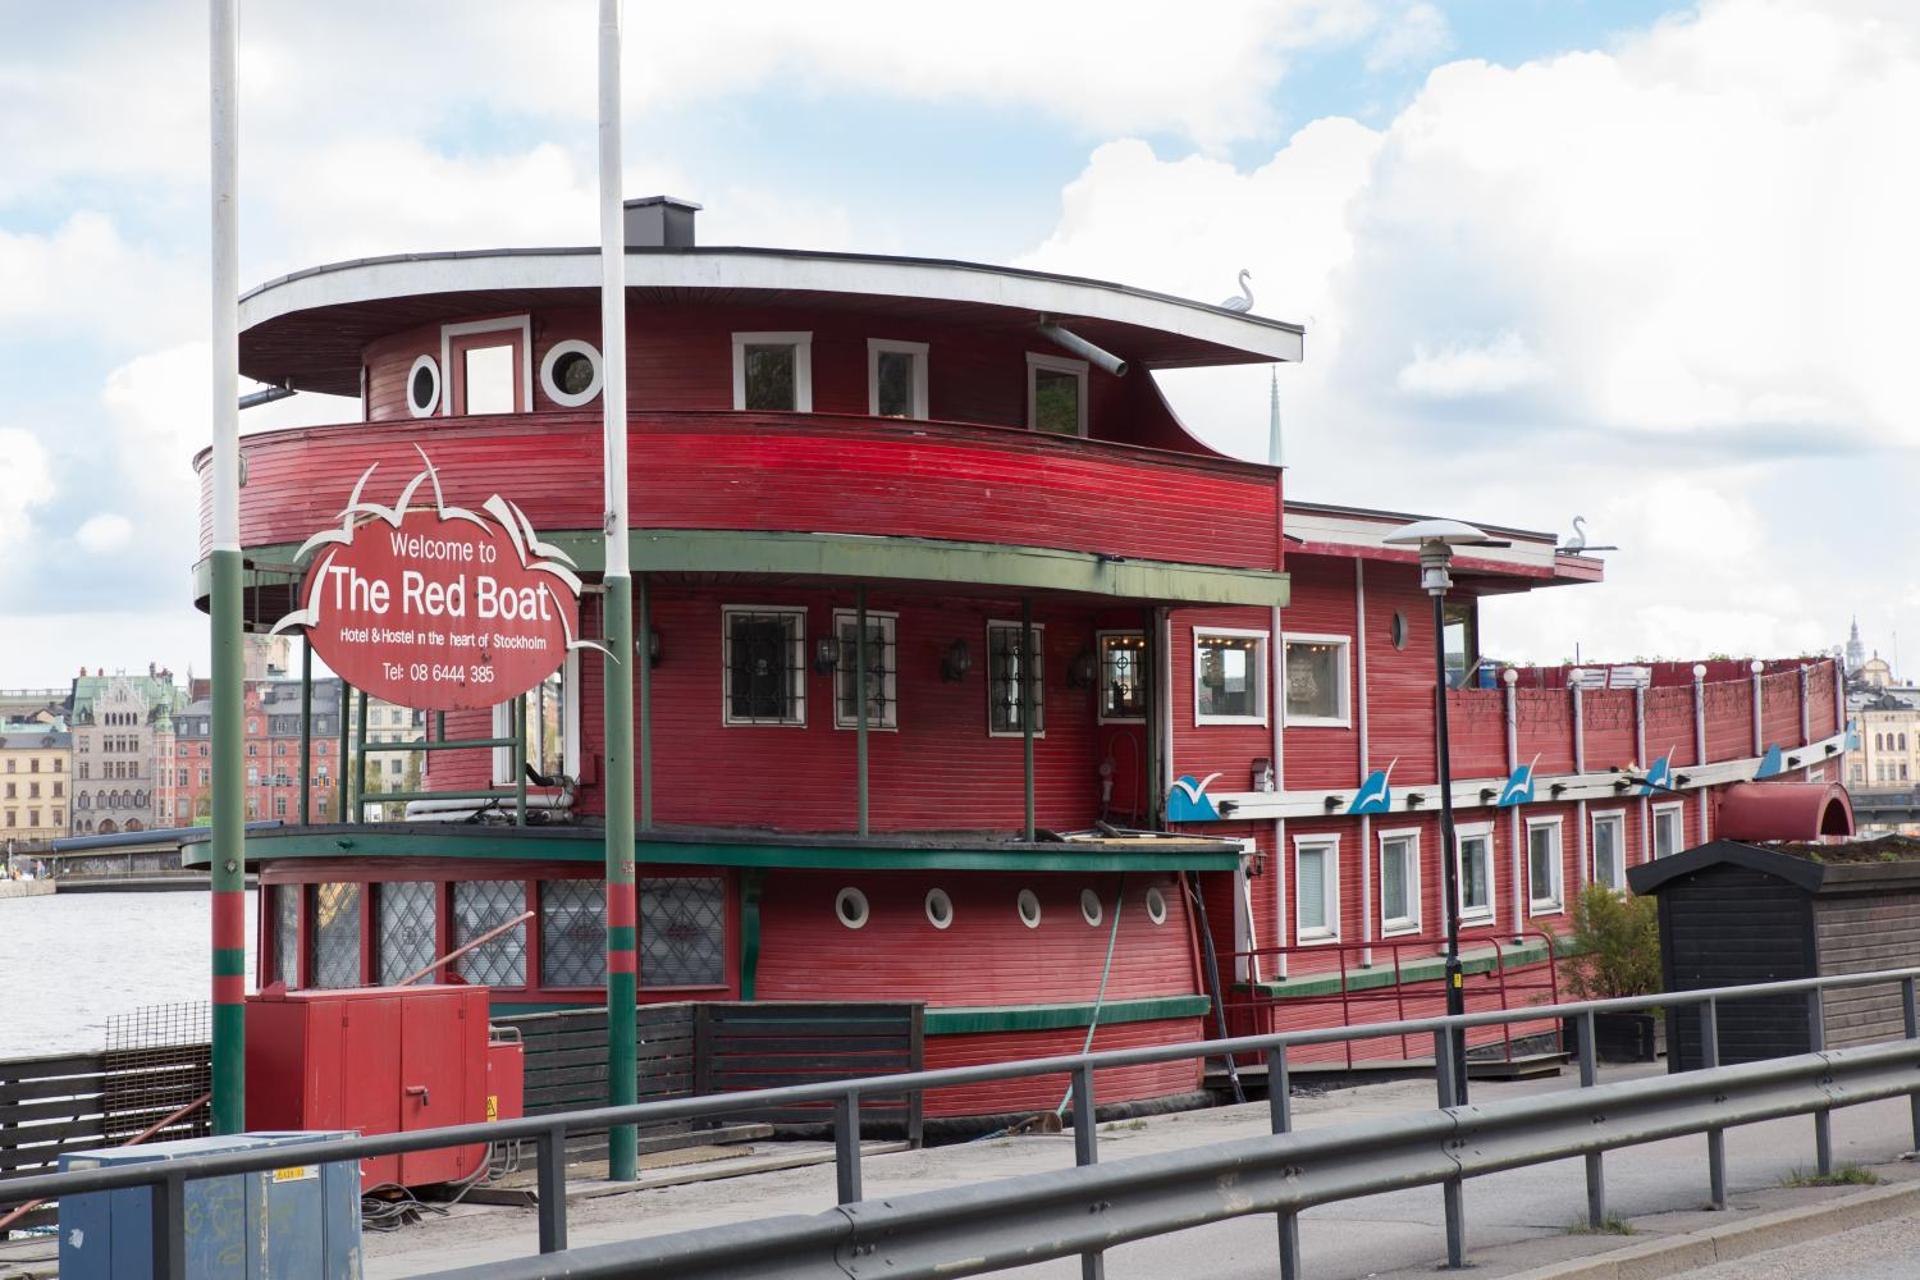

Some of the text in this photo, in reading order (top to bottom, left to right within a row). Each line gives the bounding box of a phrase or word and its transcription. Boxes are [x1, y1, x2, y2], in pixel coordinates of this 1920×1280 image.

[390, 532, 496, 563] Welcome to
[328, 565, 551, 621] The Red Boat
[340, 627, 369, 644] Hotel
[371, 627, 380, 644] &
[381, 628, 414, 645] Hostel
[428, 630, 445, 646] the
[450, 632, 475, 647] heart
[478, 632, 489, 648] of
[493, 633, 547, 650] Stockholm
[382, 662, 495, 683] Tel: 08 6444 385
